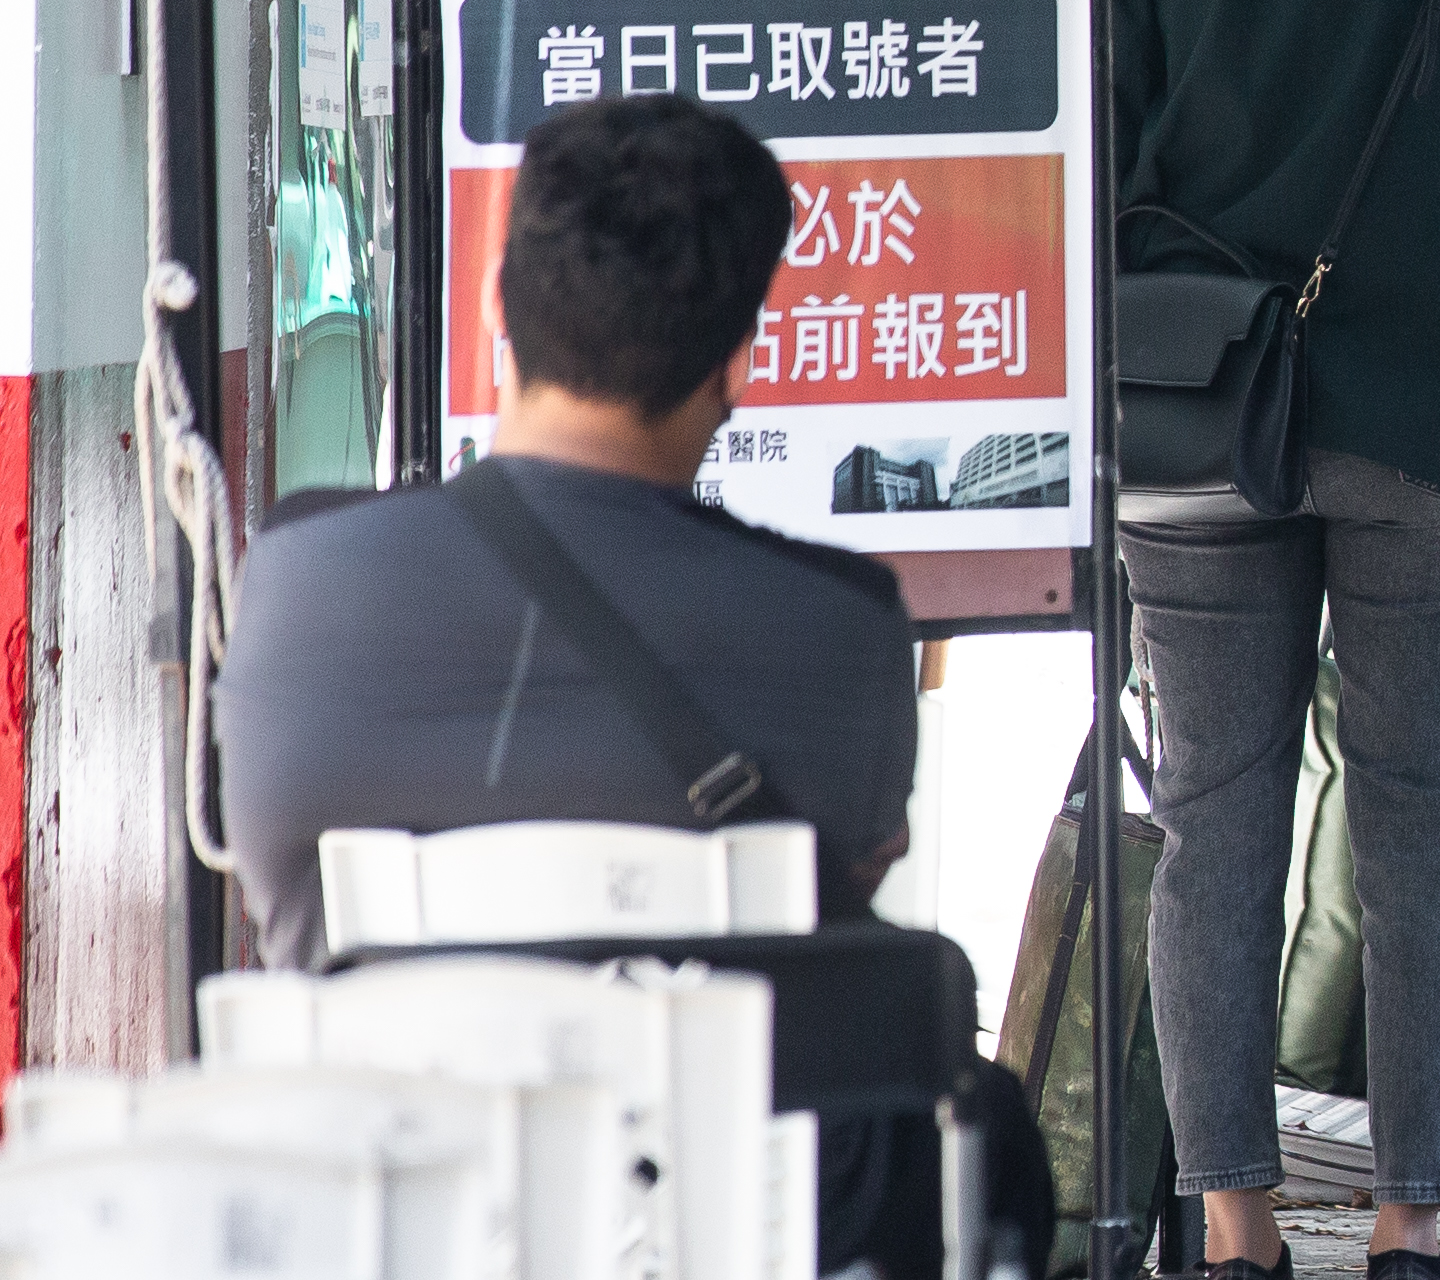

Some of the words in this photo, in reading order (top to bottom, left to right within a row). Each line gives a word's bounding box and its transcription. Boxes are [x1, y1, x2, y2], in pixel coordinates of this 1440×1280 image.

[538, 16, 985, 107] 當日已取號者
[785, 177, 922, 268] 必於
